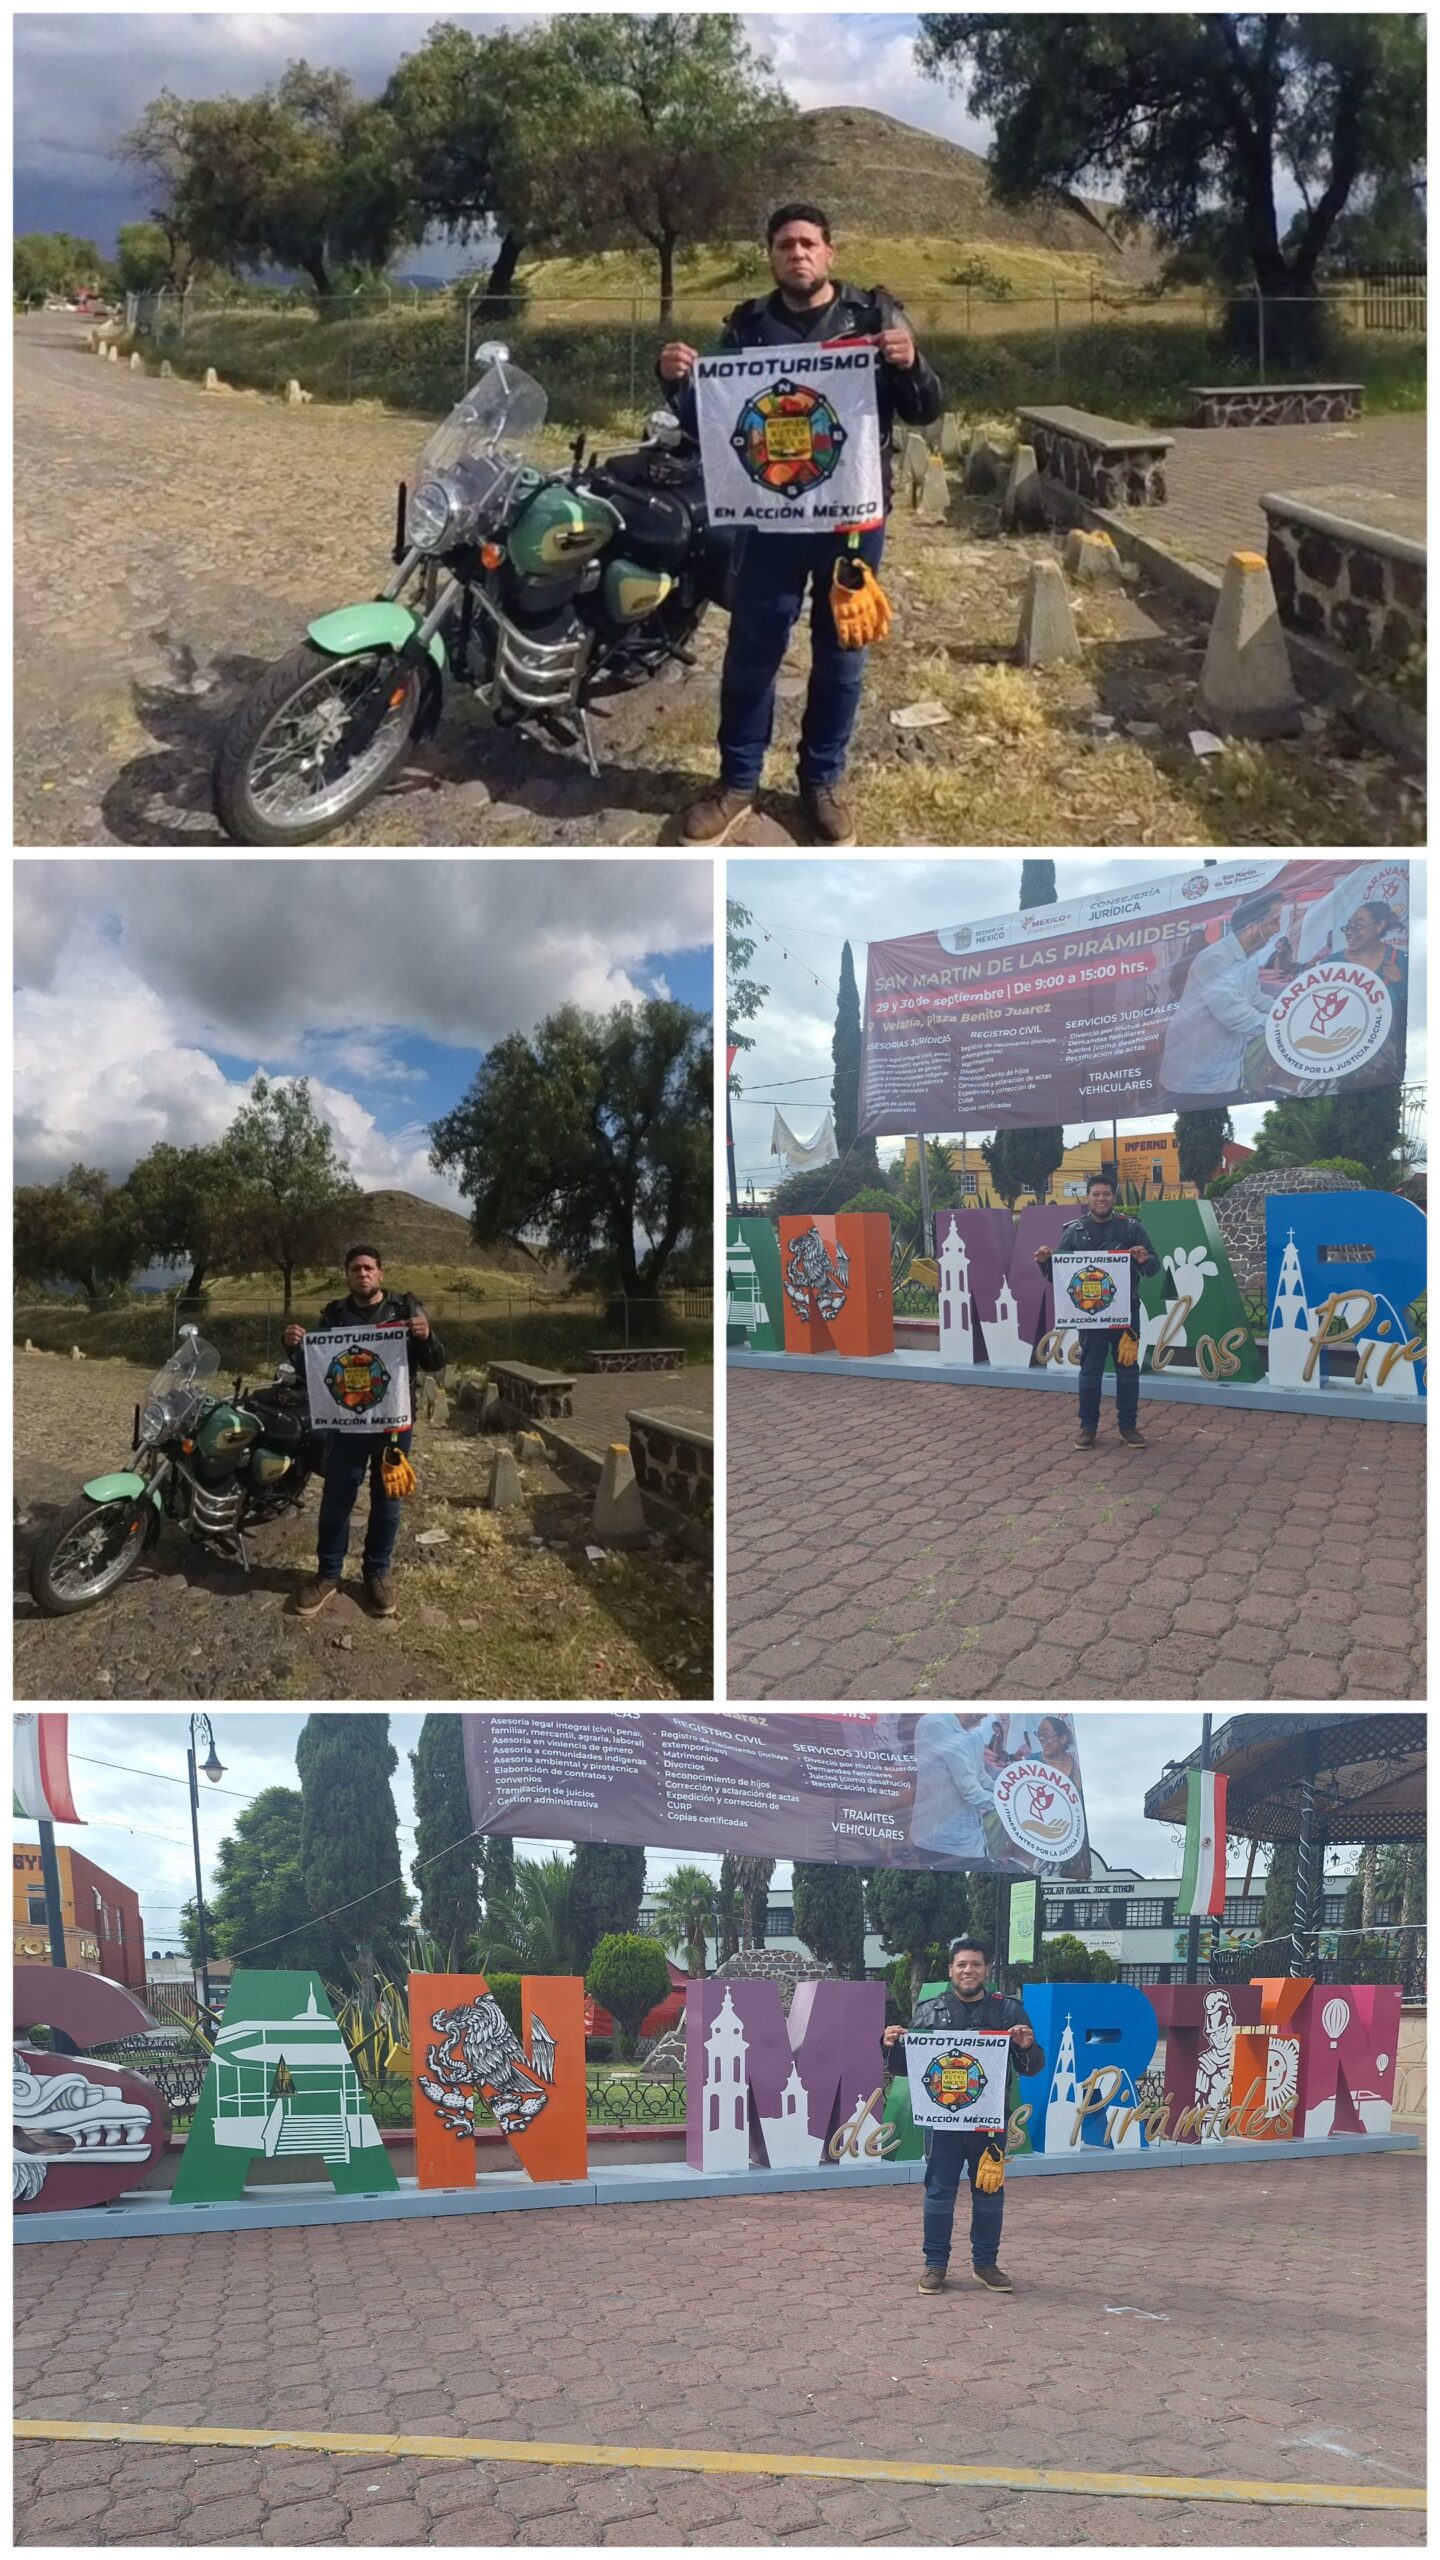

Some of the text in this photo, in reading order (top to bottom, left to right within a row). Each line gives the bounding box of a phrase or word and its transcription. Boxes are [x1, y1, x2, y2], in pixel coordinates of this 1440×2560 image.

[698, 352, 868, 378] MOTOTURISMO
[778, 382, 792, 393] N
[714, 500, 877, 520] EN ACCIÓN MÉXICO
[1090, 888, 1160, 909] CONSEJERÍA
[1089, 902, 1141, 921] JURÍDICA
[976, 928, 995, 937] ESTADO
[976, 932, 1004, 943] MÉXICO
[875, 974, 907, 992] SAN
[913, 963, 981, 987] MARTIN
[987, 957, 1013, 976] DE
[1020, 948, 1057, 969] LAS
[1064, 920, 1190, 960] PIRÁMIDES
[876, 961, 1149, 1013] 29 y 30 de septiembre De 9:00 a 15:00 hrs.
[1272, 968, 1385, 1021] CARAVANAS
[961, 1007, 1002, 1023] Benito
[1005, 1002, 1051, 1017] Juarez
[1066, 1002, 1180, 1028] SERVICIOS JUDICIALES
[970, 1025, 1042, 1038] REGISTRO CIVIL
[1274, 1029, 1303, 1070] ITINERANTES
[1304, 1065, 1321, 1073] POR
[1336, 1045, 1370, 1071] JUSTICIA
[1369, 1014, 1382, 1045] SOCIAL
[1089, 1068, 1142, 1082] TRAMITES
[1079, 1080, 1152, 1095] VEHICULARES
[1054, 1256, 1129, 1264] MOTOTURISMO
[306, 1331, 404, 1345] MOTOTURISMO
[332, 1416, 367, 1426] ACCIÓN
[371, 1414, 408, 1425] MÉXICO
[491, 1718, 642, 1738] Asesoría legal integral (civil, penal,
[661, 1730, 698, 1741] Registro
[672, 1718, 766, 1746] REGISTRO CIVIL
[491, 1727, 644, 1748] familiar, mercantil, agraria, laboral)
[547, 1740, 587, 1750] violencia
[603, 1745, 633, 1755] género
[793, 1744, 918, 1762] SERVICIOS JUDICIALES
[542, 1749, 602, 1761] comunidades
[604, 1754, 647, 1766] indígenas
[663, 1751, 719, 1763] Matrimonios
[803, 1757, 837, 1767] Divorcio
[854, 1763, 882, 1771] mutuo
[494, 1766, 548, 1774] Elaboración
[565, 1770, 606, 1780] contratos
[535, 1758, 581, 1768] ambiental
[590, 1763, 638, 1774] pirotécnica
[664, 1760, 705, 1771] Divorcios
[806, 1764, 851, 1775] Demandas
[496, 1775, 542, 1784] convenios
[665, 1771, 736, 1784] Reconocimiento
[750, 1779, 770, 1789] hijos
[808, 1773, 911, 1789] Juicios (como desahucio)
[811, 1780, 865, 1792] Rectificación
[997, 1764, 1079, 1805] CARAVANAS
[496, 1786, 595, 1798] Tramitación de juicios
[665, 1781, 713, 1792] Corrección
[722, 1787, 764, 1798] aclaración
[766, 1792, 777, 1800] de
[778, 1794, 800, 1803] actas
[498, 1795, 598, 1809] Gestión administrativa
[666, 1791, 714, 1803] Expedición
[723, 1797, 767, 1809] corrección
[769, 1802, 780, 1810] de
[667, 1812, 748, 1827] Copias certificadas
[842, 1808, 895, 1825] TRAMITES
[831, 1822, 904, 1840] VEHICULARES
[1004, 1808, 1035, 1849] ITINERANTES
[1036, 1846, 1050, 1855] POR
[1058, 1838, 1078, 1856] JUSTICIA
[906, 2036, 1006, 2048] MOTOTURISMO
[829, 2065, 1299, 2159] de Pirámides
[926, 2114, 960, 2123] ACCIÓN
[964, 2114, 1000, 2124] MÉXICO
